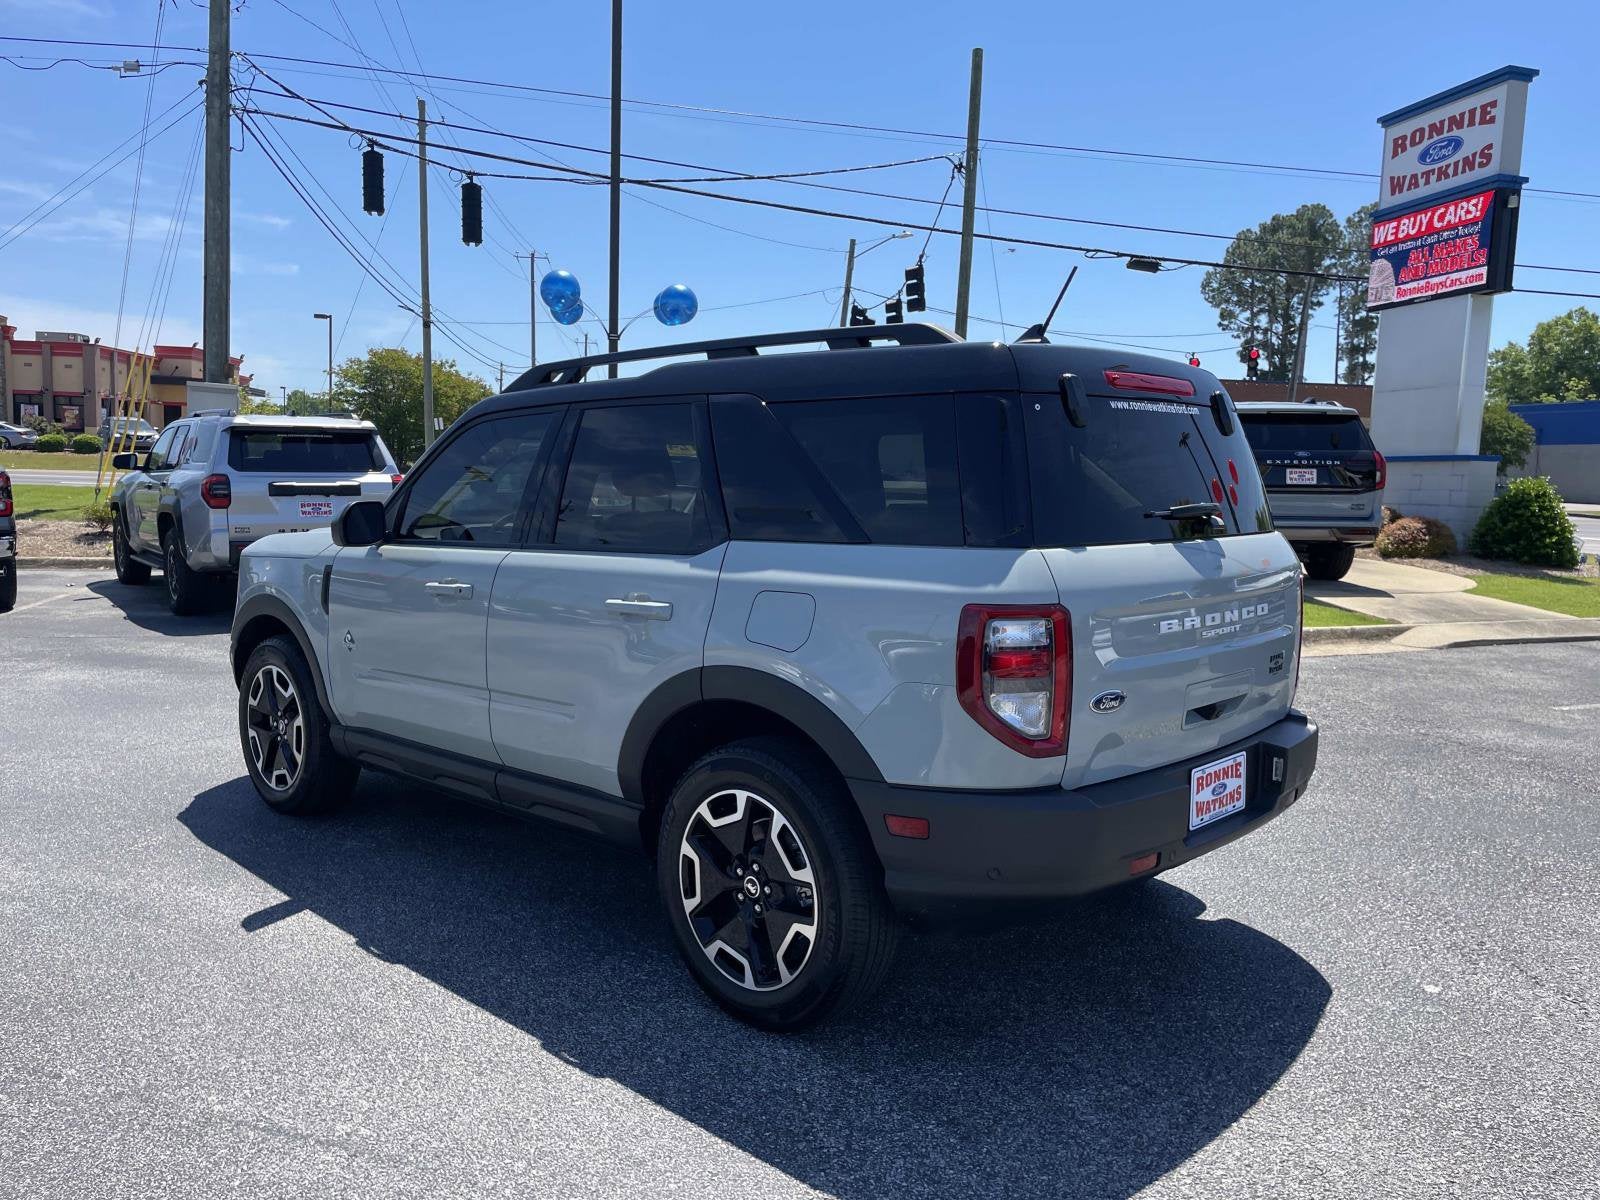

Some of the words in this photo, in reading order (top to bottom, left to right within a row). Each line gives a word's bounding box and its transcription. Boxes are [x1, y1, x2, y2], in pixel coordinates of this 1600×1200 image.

[1391, 99, 1498, 160] RONNIE
[1425, 141, 1455, 163] Ford
[1389, 143, 1494, 196] WATKINS
[1374, 221, 1398, 246] WE
[1398, 212, 1432, 239] BUY
[1433, 196, 1484, 228] CARS!
[1398, 262, 1427, 283] AND
[1427, 248, 1488, 277] MODELS!
[1407, 247, 1431, 265] ALL
[1432, 234, 1480, 259] MAKES
[1396, 272, 1484, 299] RonnieBuysCars.com
[1109, 401, 1200, 414] www.ronniewatkinsford.com
[1160, 603, 1269, 634] BRONCO
[1202, 624, 1241, 638] SPORT
[1195, 761, 1242, 796] RONNIE
[1195, 785, 1242, 818] WATKINS
